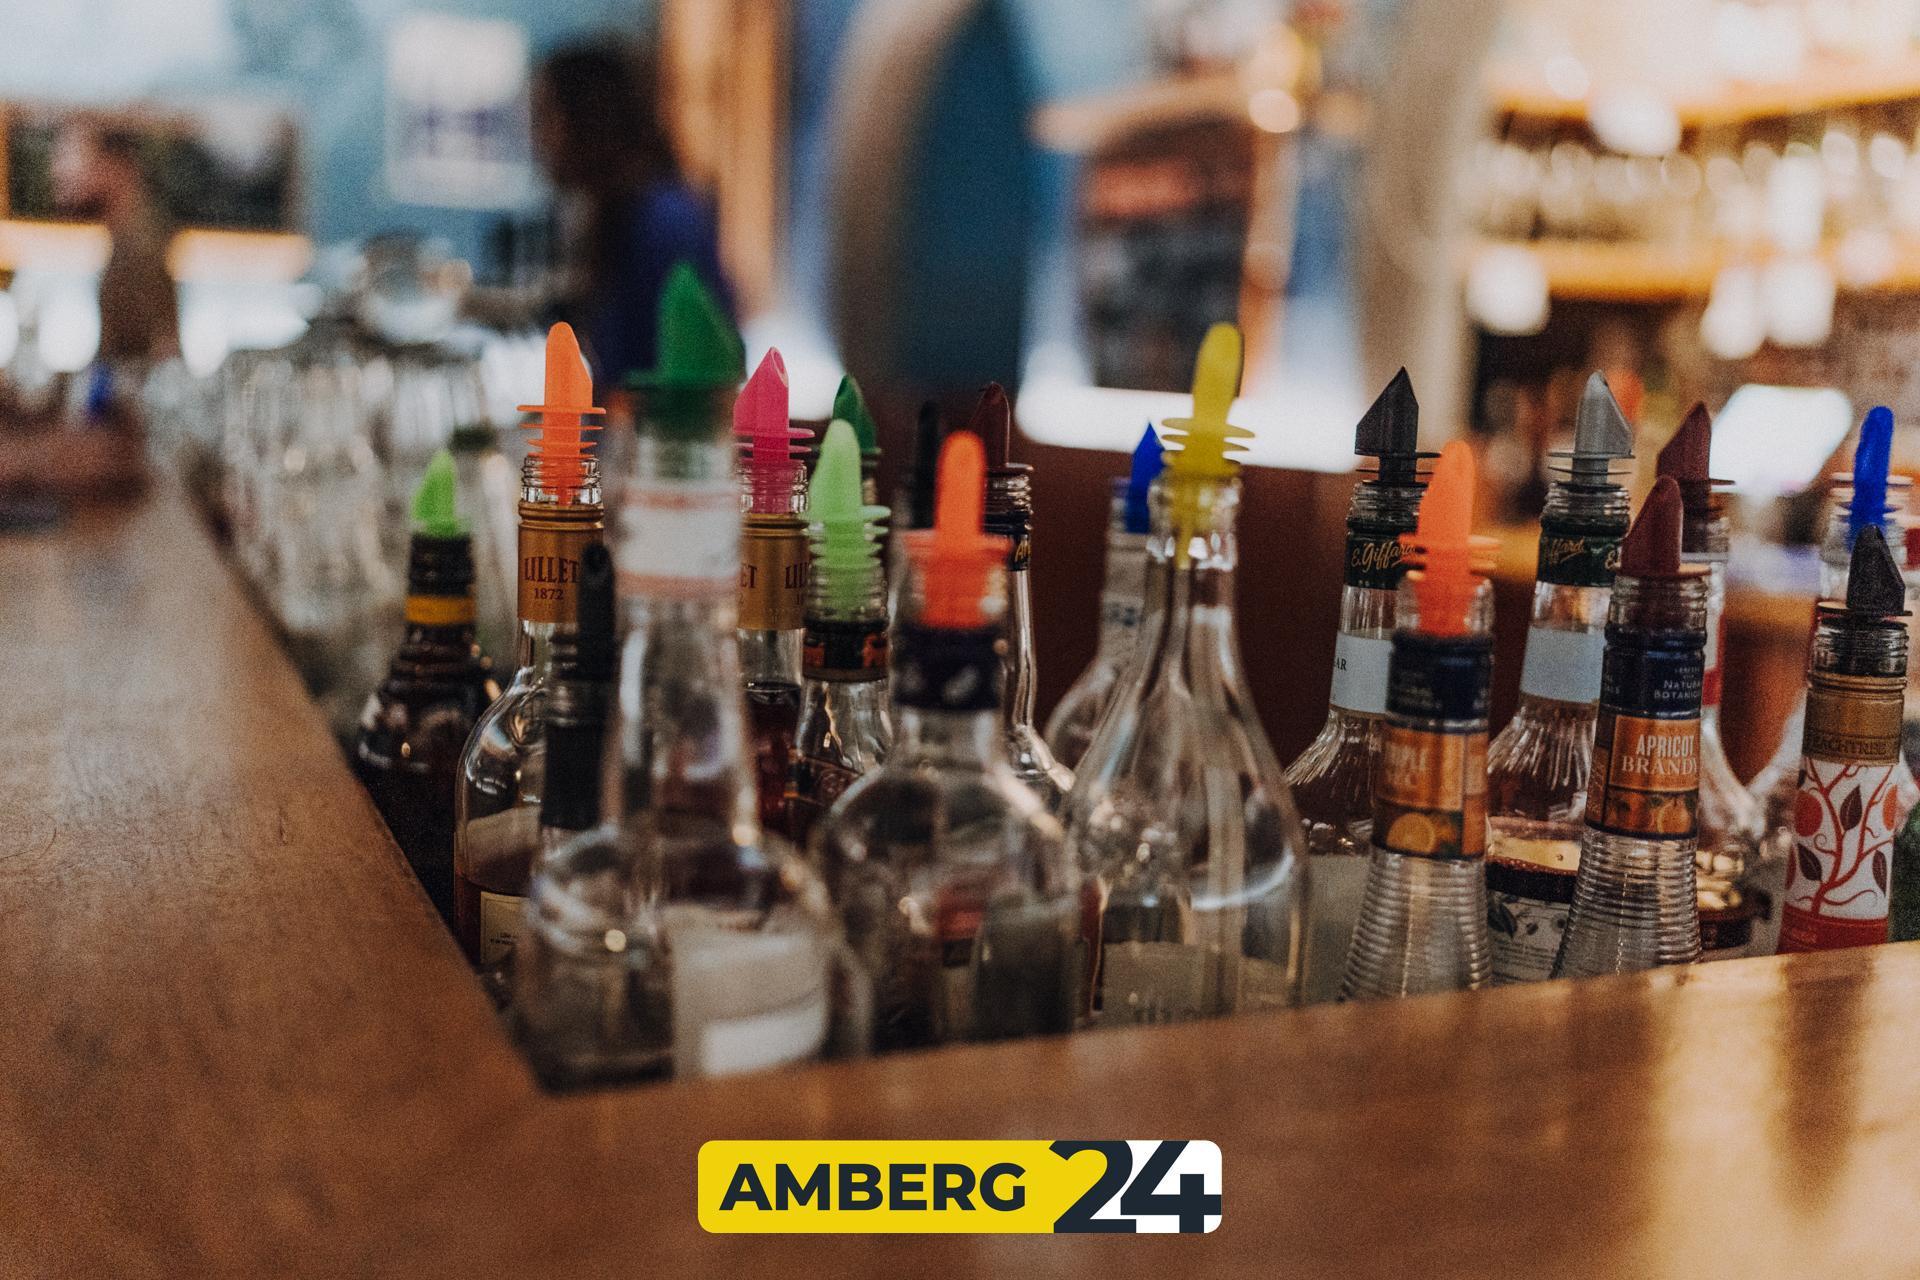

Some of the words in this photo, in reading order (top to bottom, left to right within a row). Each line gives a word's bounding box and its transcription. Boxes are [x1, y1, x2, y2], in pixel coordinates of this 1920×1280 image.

[524, 556, 581, 584] LILLET
[533, 587, 565, 601] 1872
[1635, 733, 1696, 758] APRICOT
